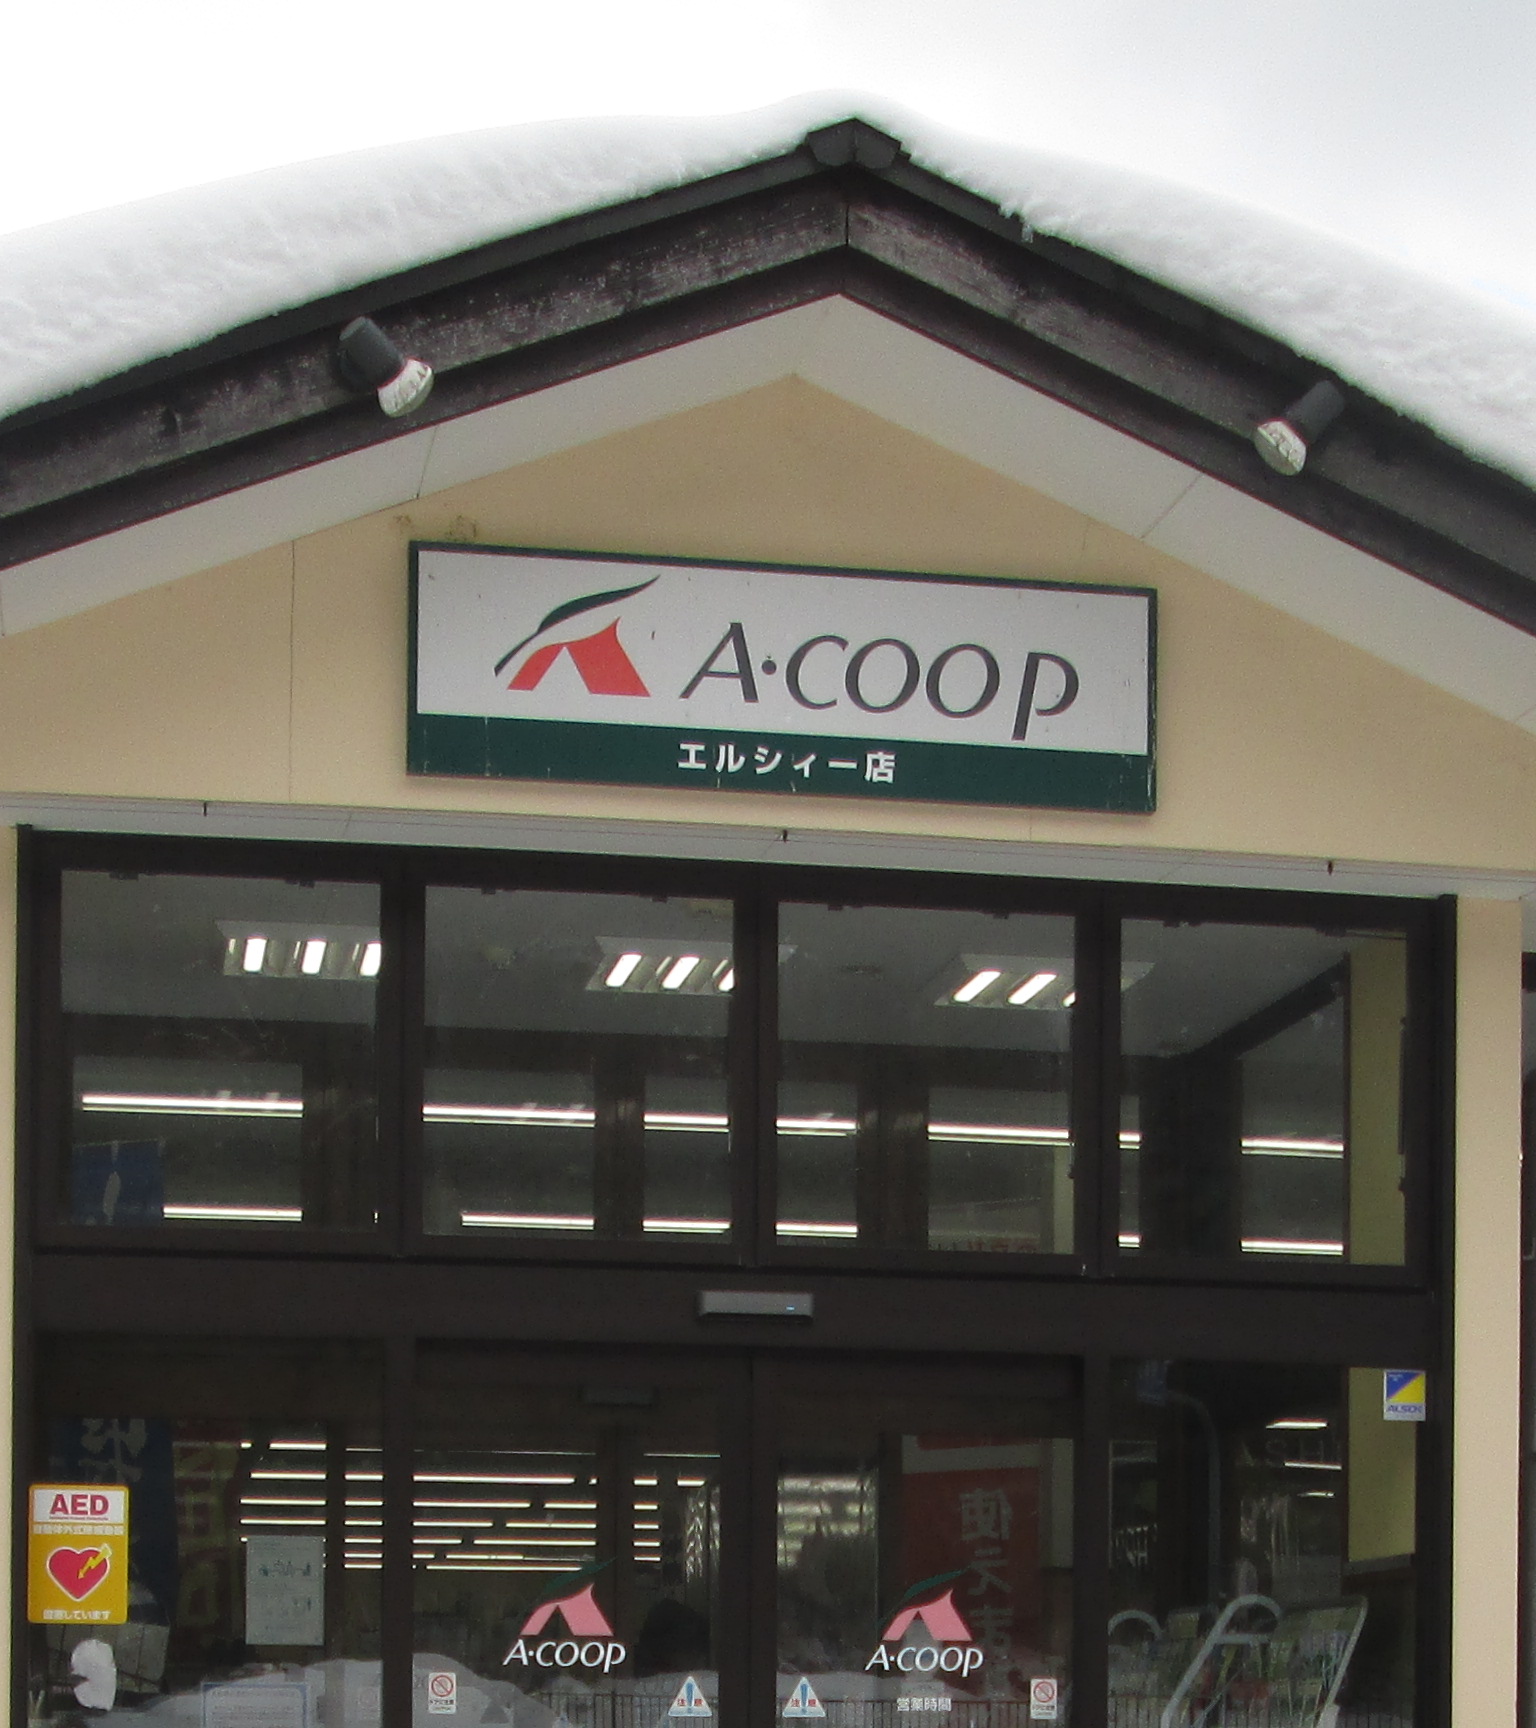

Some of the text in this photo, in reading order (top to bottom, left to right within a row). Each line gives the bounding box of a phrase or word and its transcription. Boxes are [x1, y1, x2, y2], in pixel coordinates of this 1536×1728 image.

[677, 742, 896, 784] エルシィー店
[49, 1494, 110, 1515] AED
[896, 1697, 952, 1712] 営業時間
